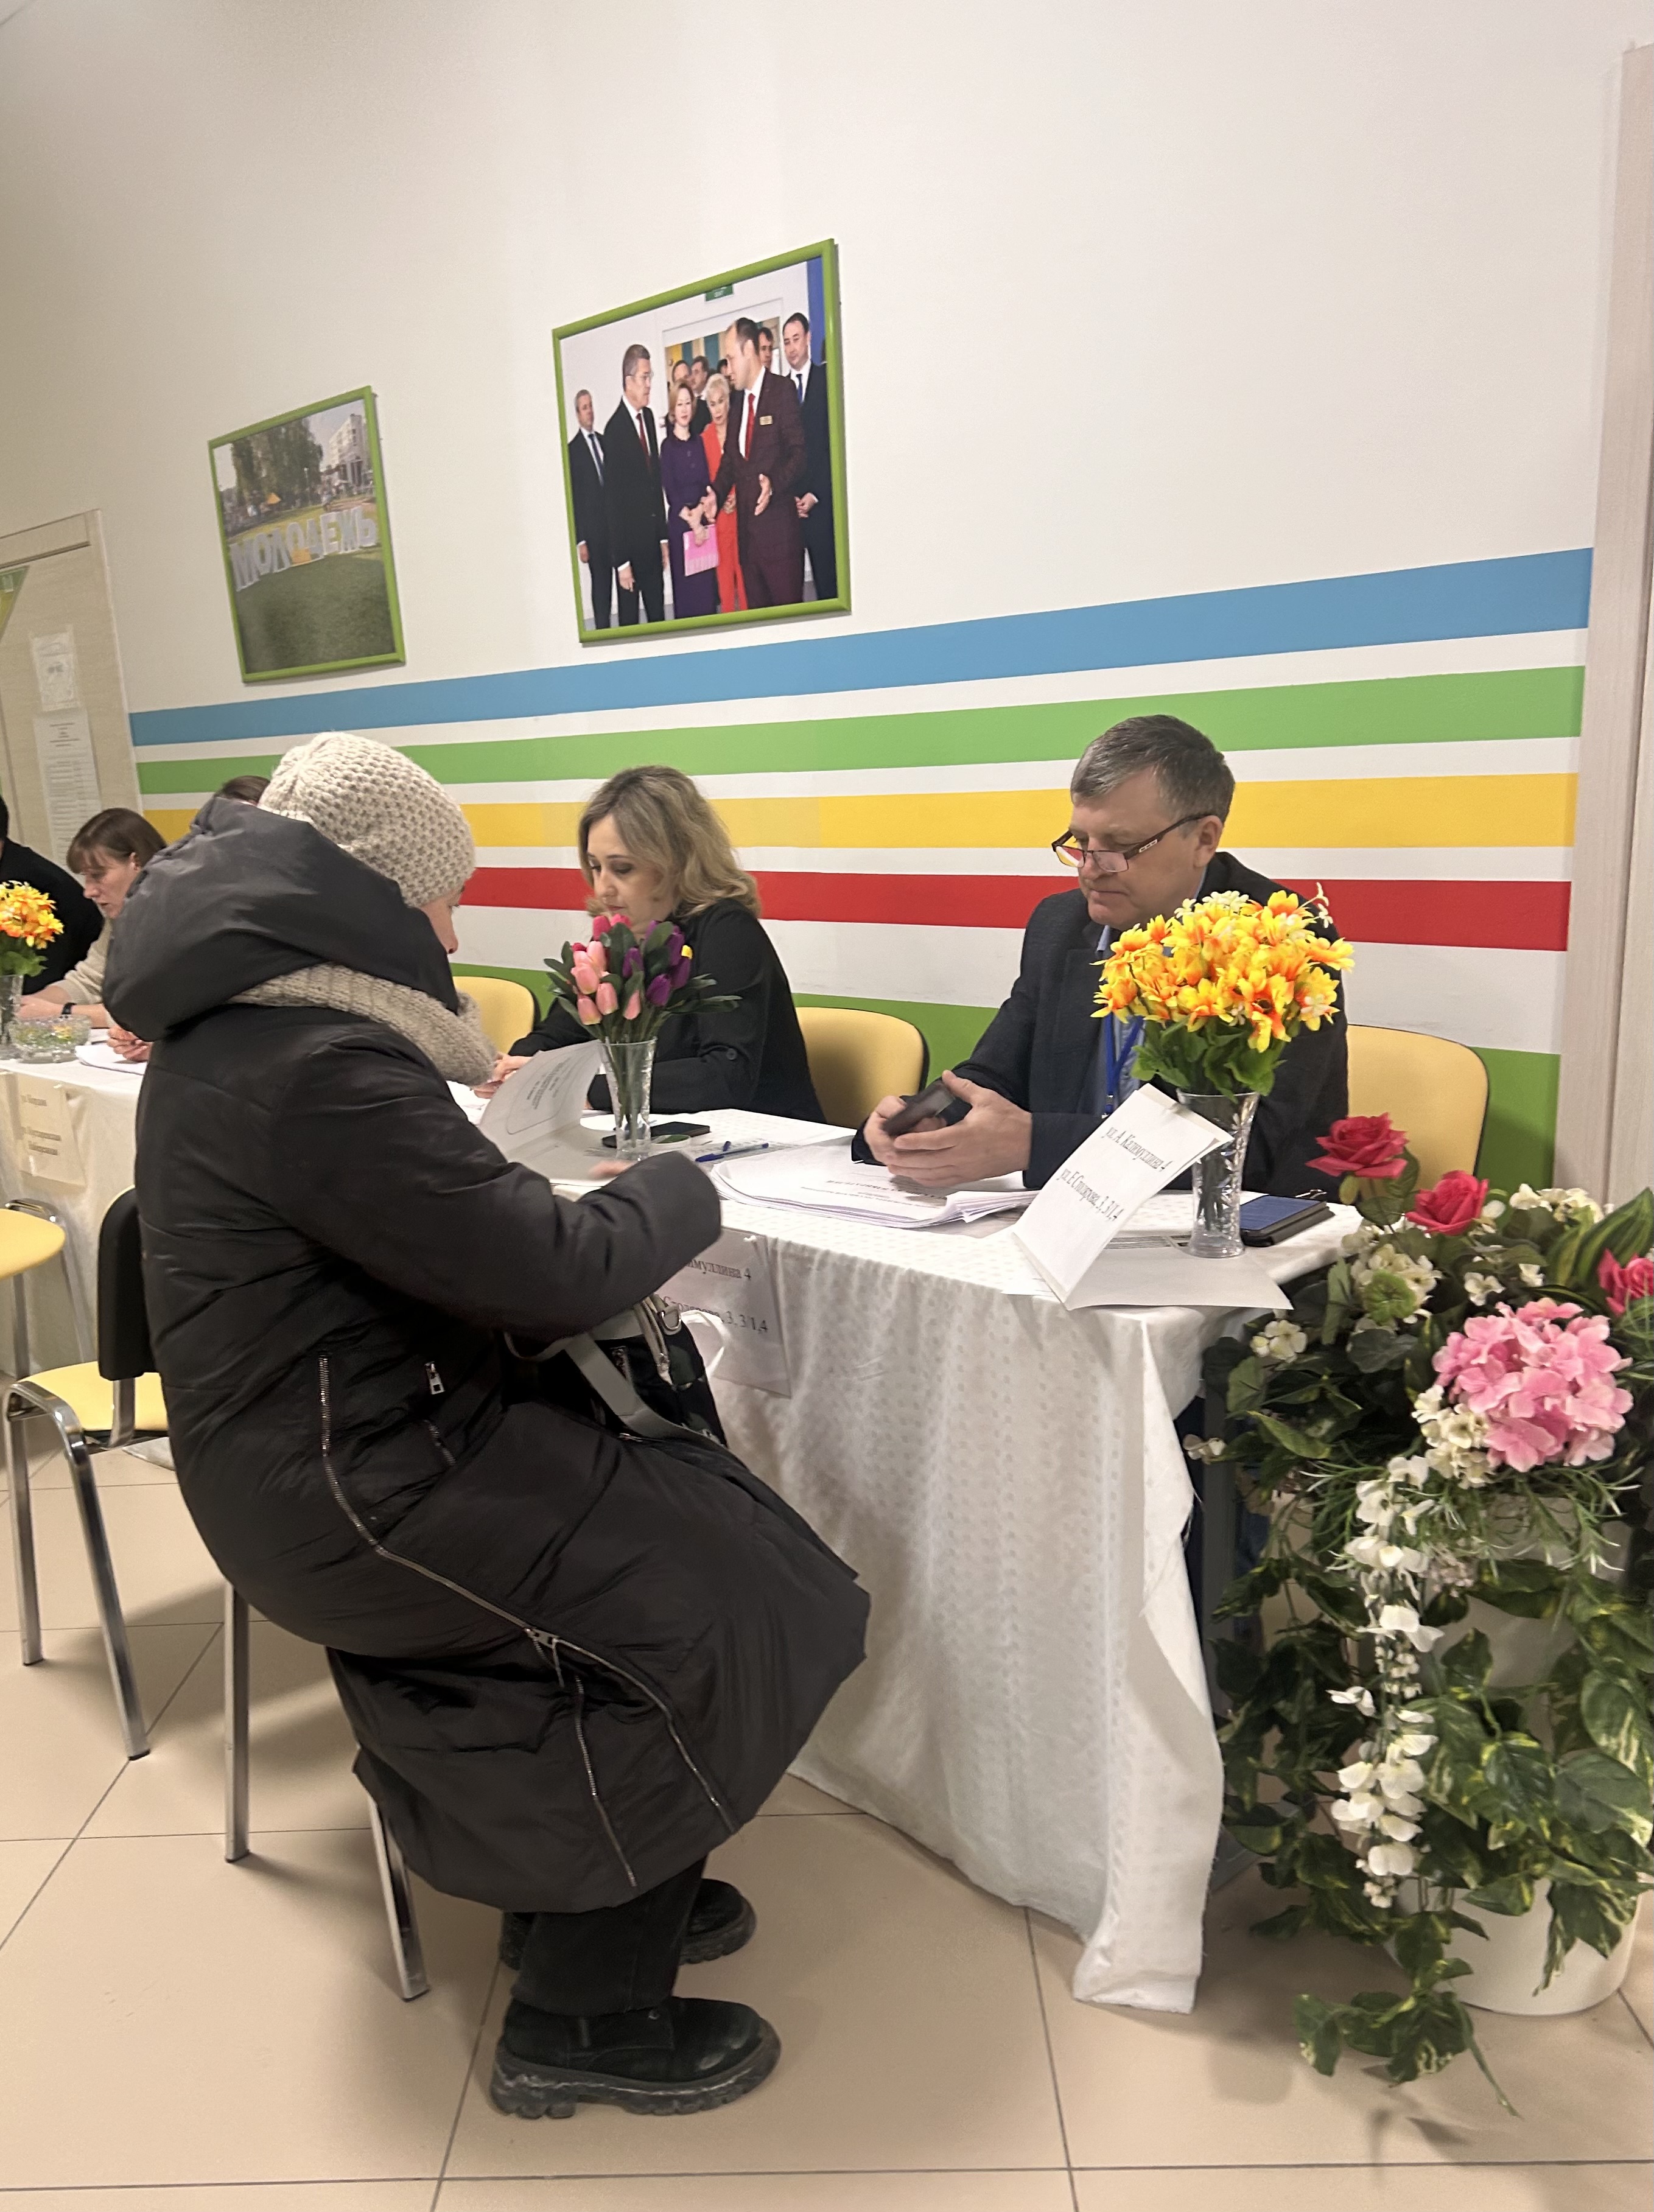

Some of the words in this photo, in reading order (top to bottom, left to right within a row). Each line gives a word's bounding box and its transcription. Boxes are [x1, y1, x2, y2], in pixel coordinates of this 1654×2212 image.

[1159, 1160, 1174, 1172] 4
[686, 1259, 742, 1279] муллина
[743, 1267, 751, 1281] 4
